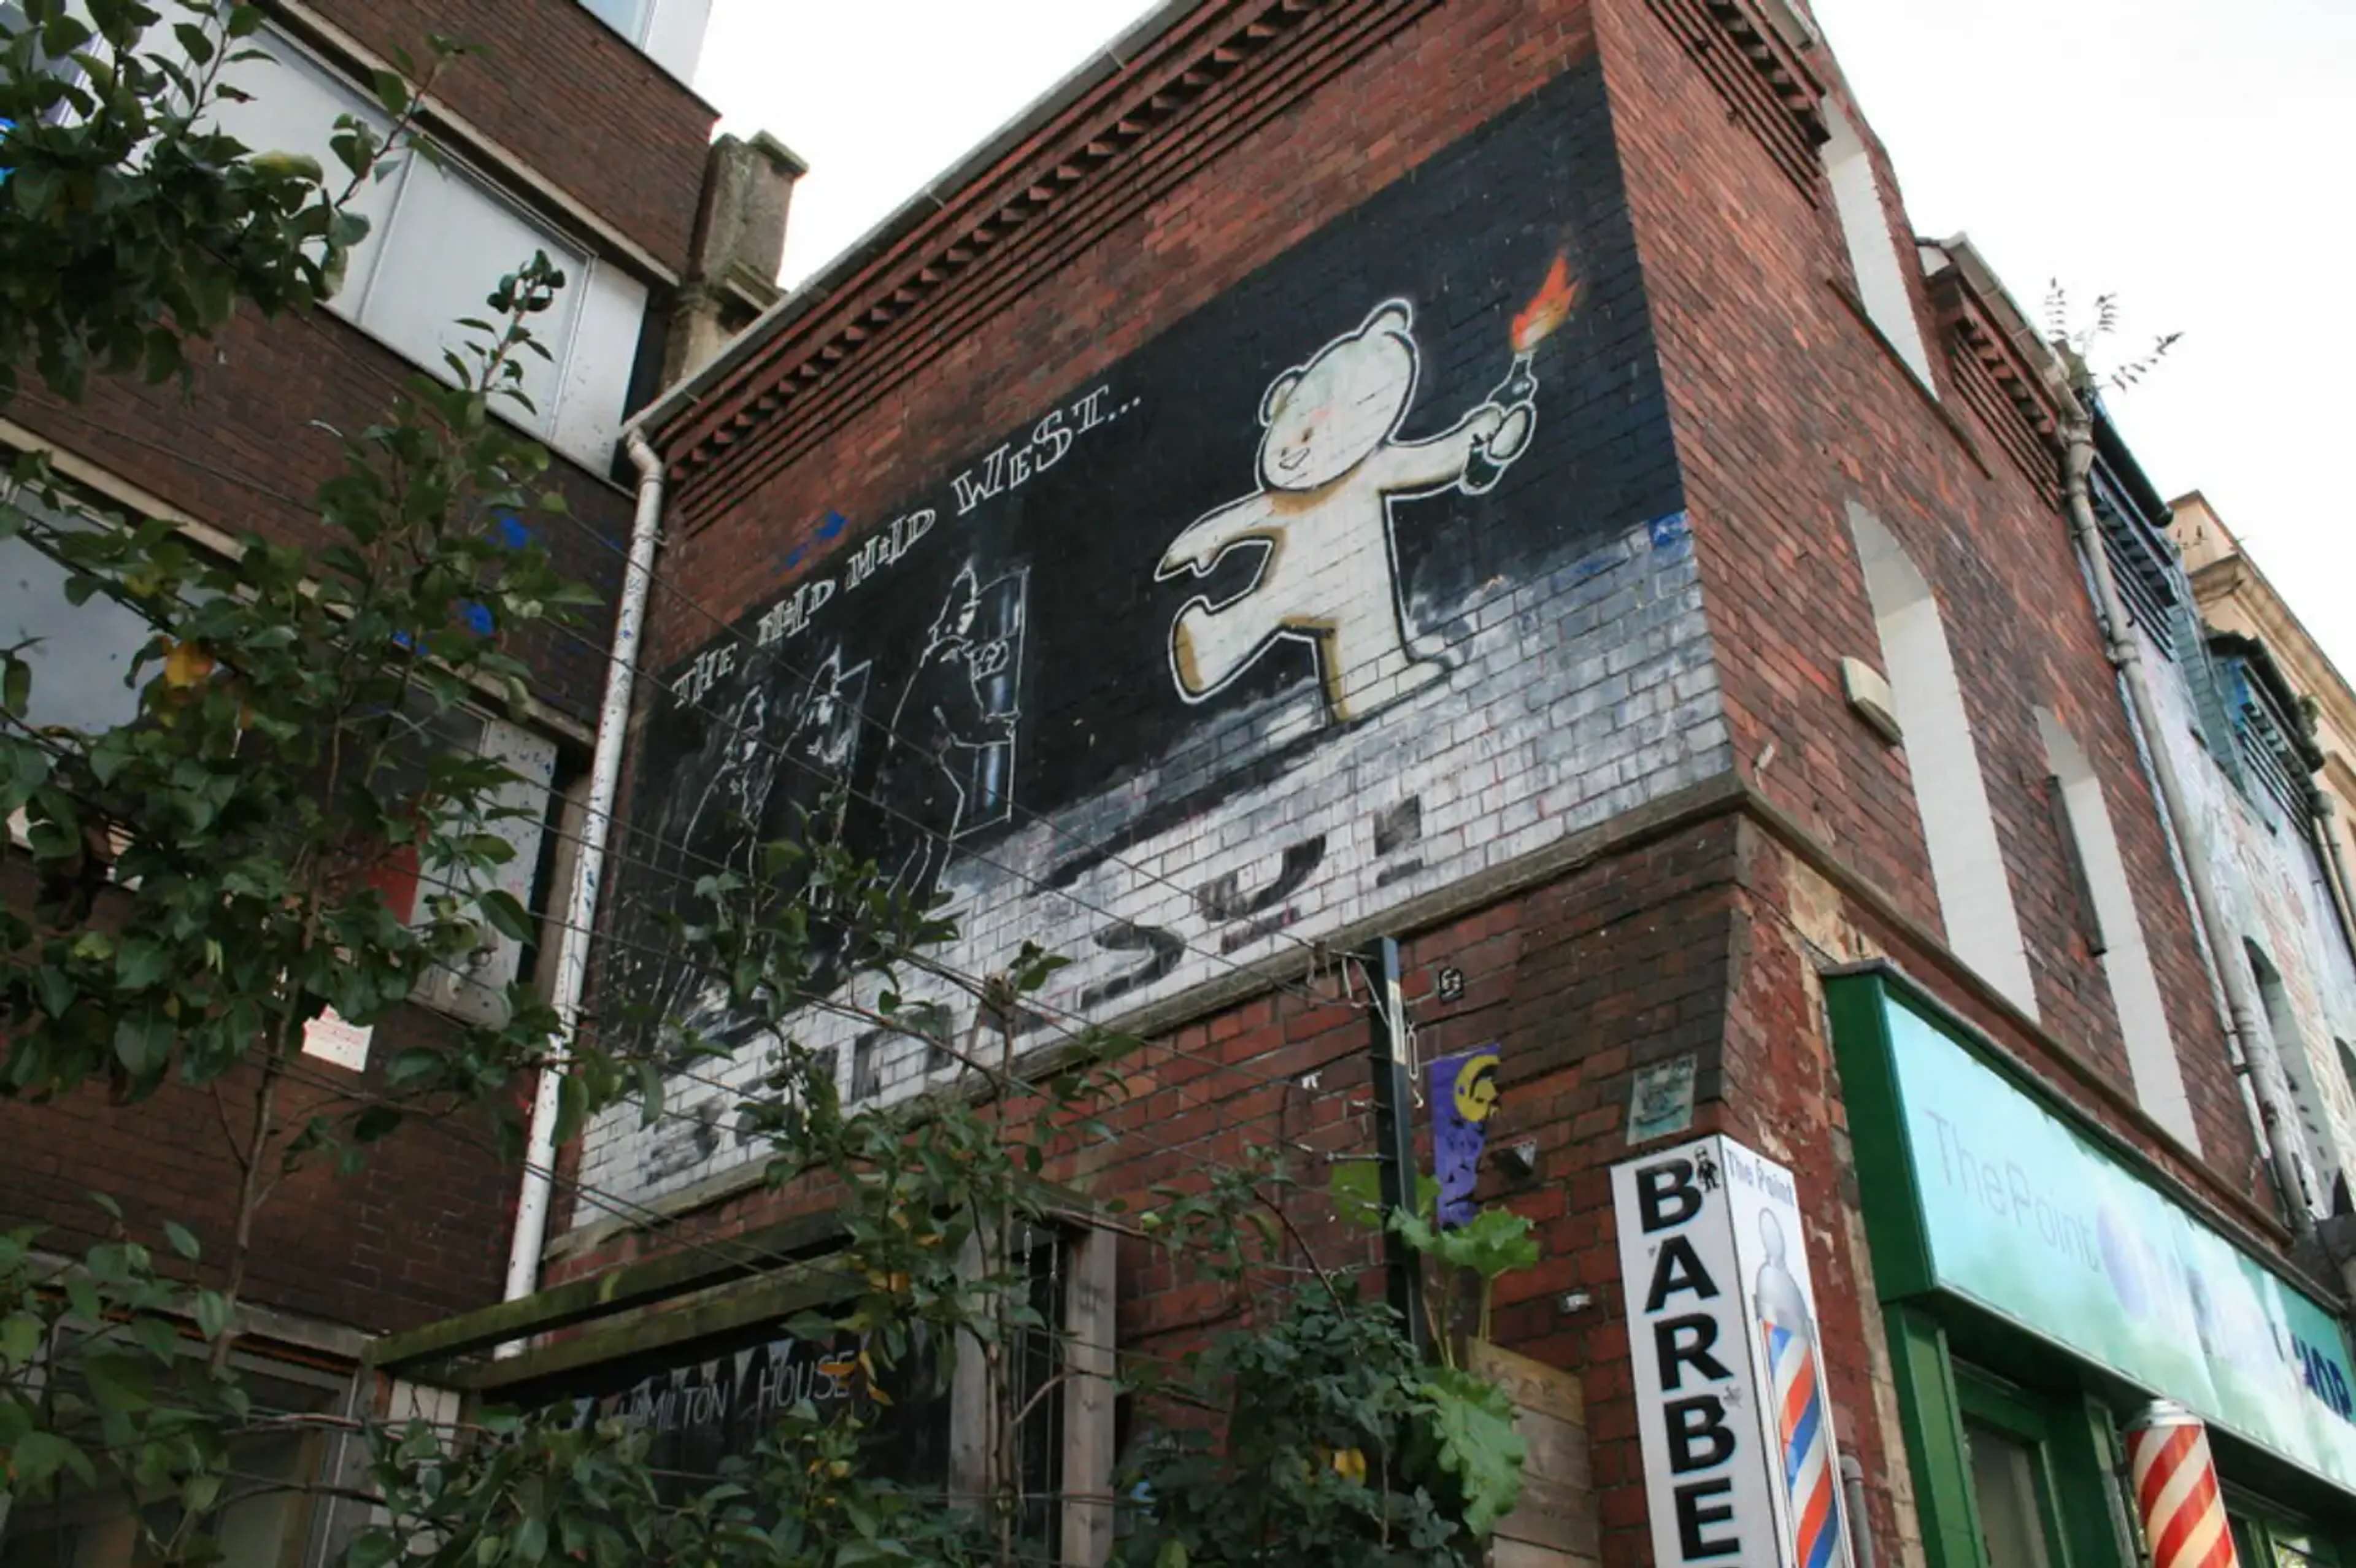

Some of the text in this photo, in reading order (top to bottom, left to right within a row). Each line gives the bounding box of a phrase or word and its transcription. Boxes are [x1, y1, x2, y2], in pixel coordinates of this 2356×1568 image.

[672, 642, 738, 708] THE
[758, 1350, 856, 1412] HOUSE
[1636, 1158, 1741, 1568] BARBE
